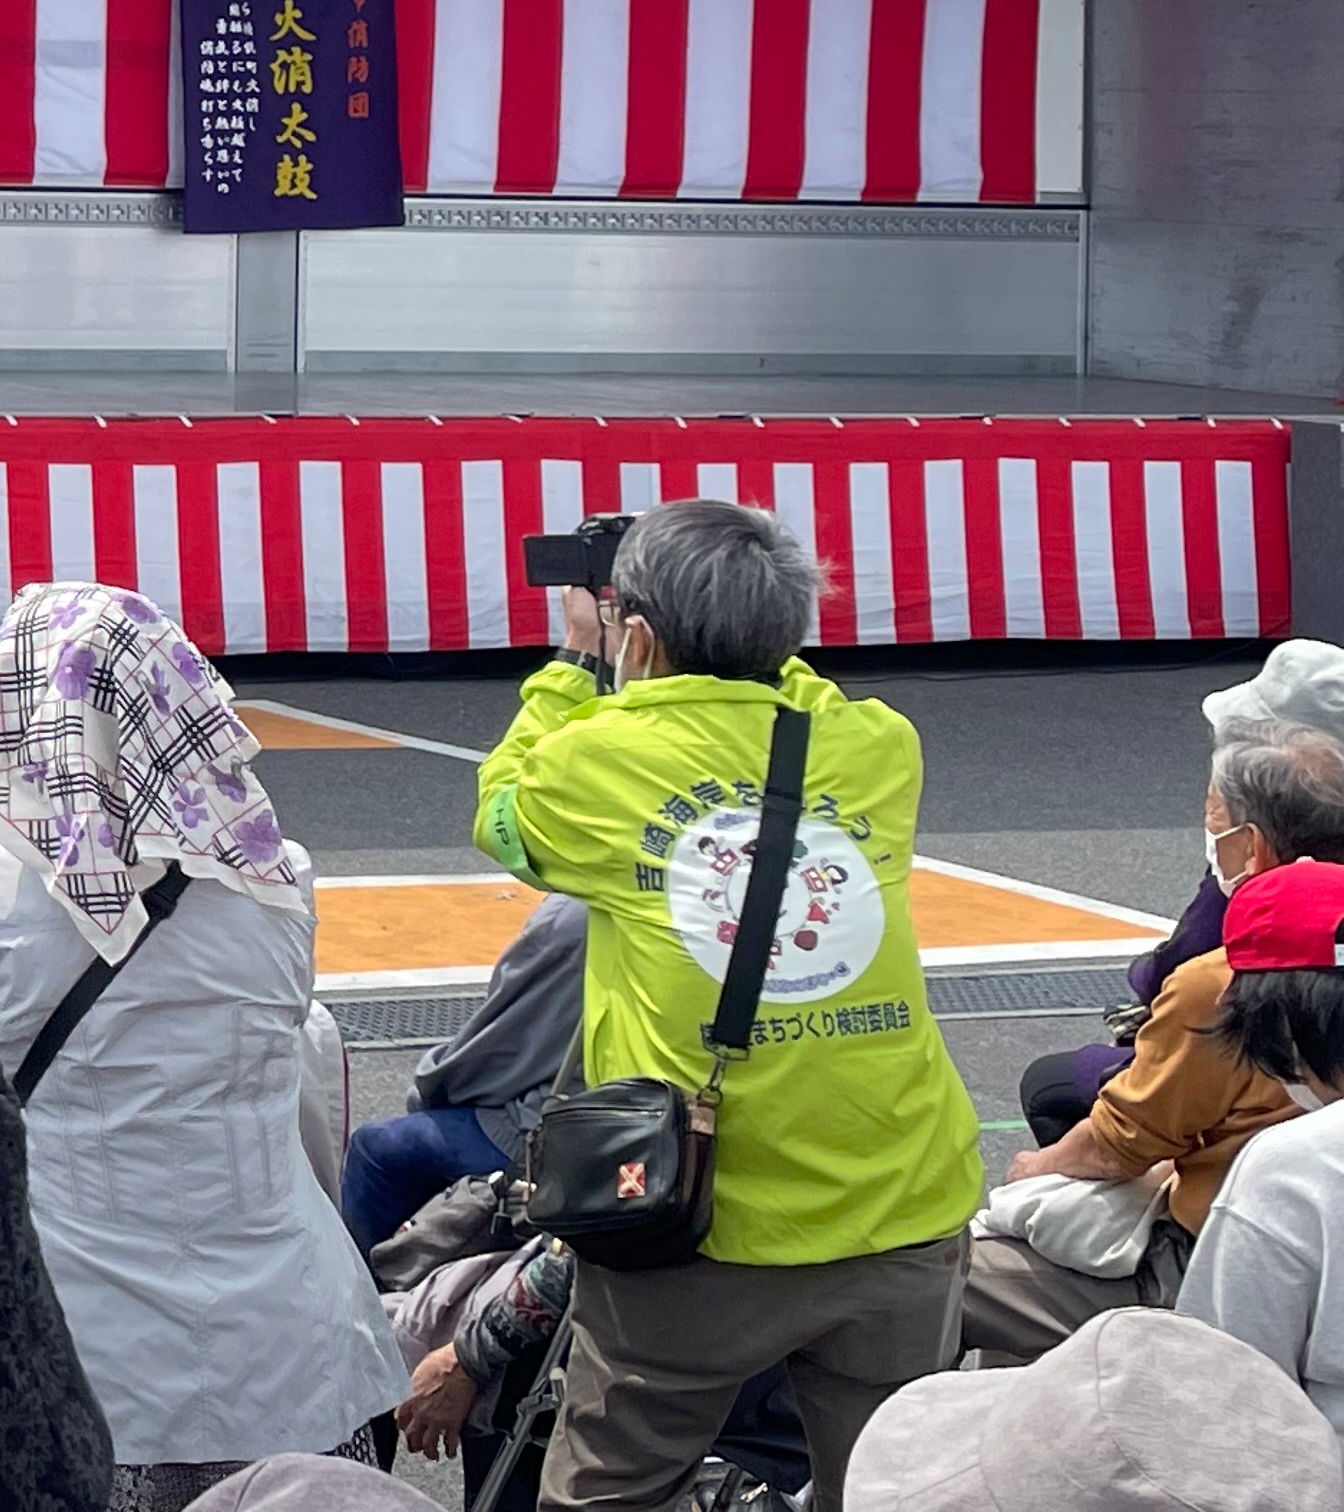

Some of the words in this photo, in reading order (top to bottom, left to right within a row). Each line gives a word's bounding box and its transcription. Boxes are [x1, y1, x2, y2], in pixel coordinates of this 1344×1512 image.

[700, 1000, 912, 1048] まちづくり検討委員会
